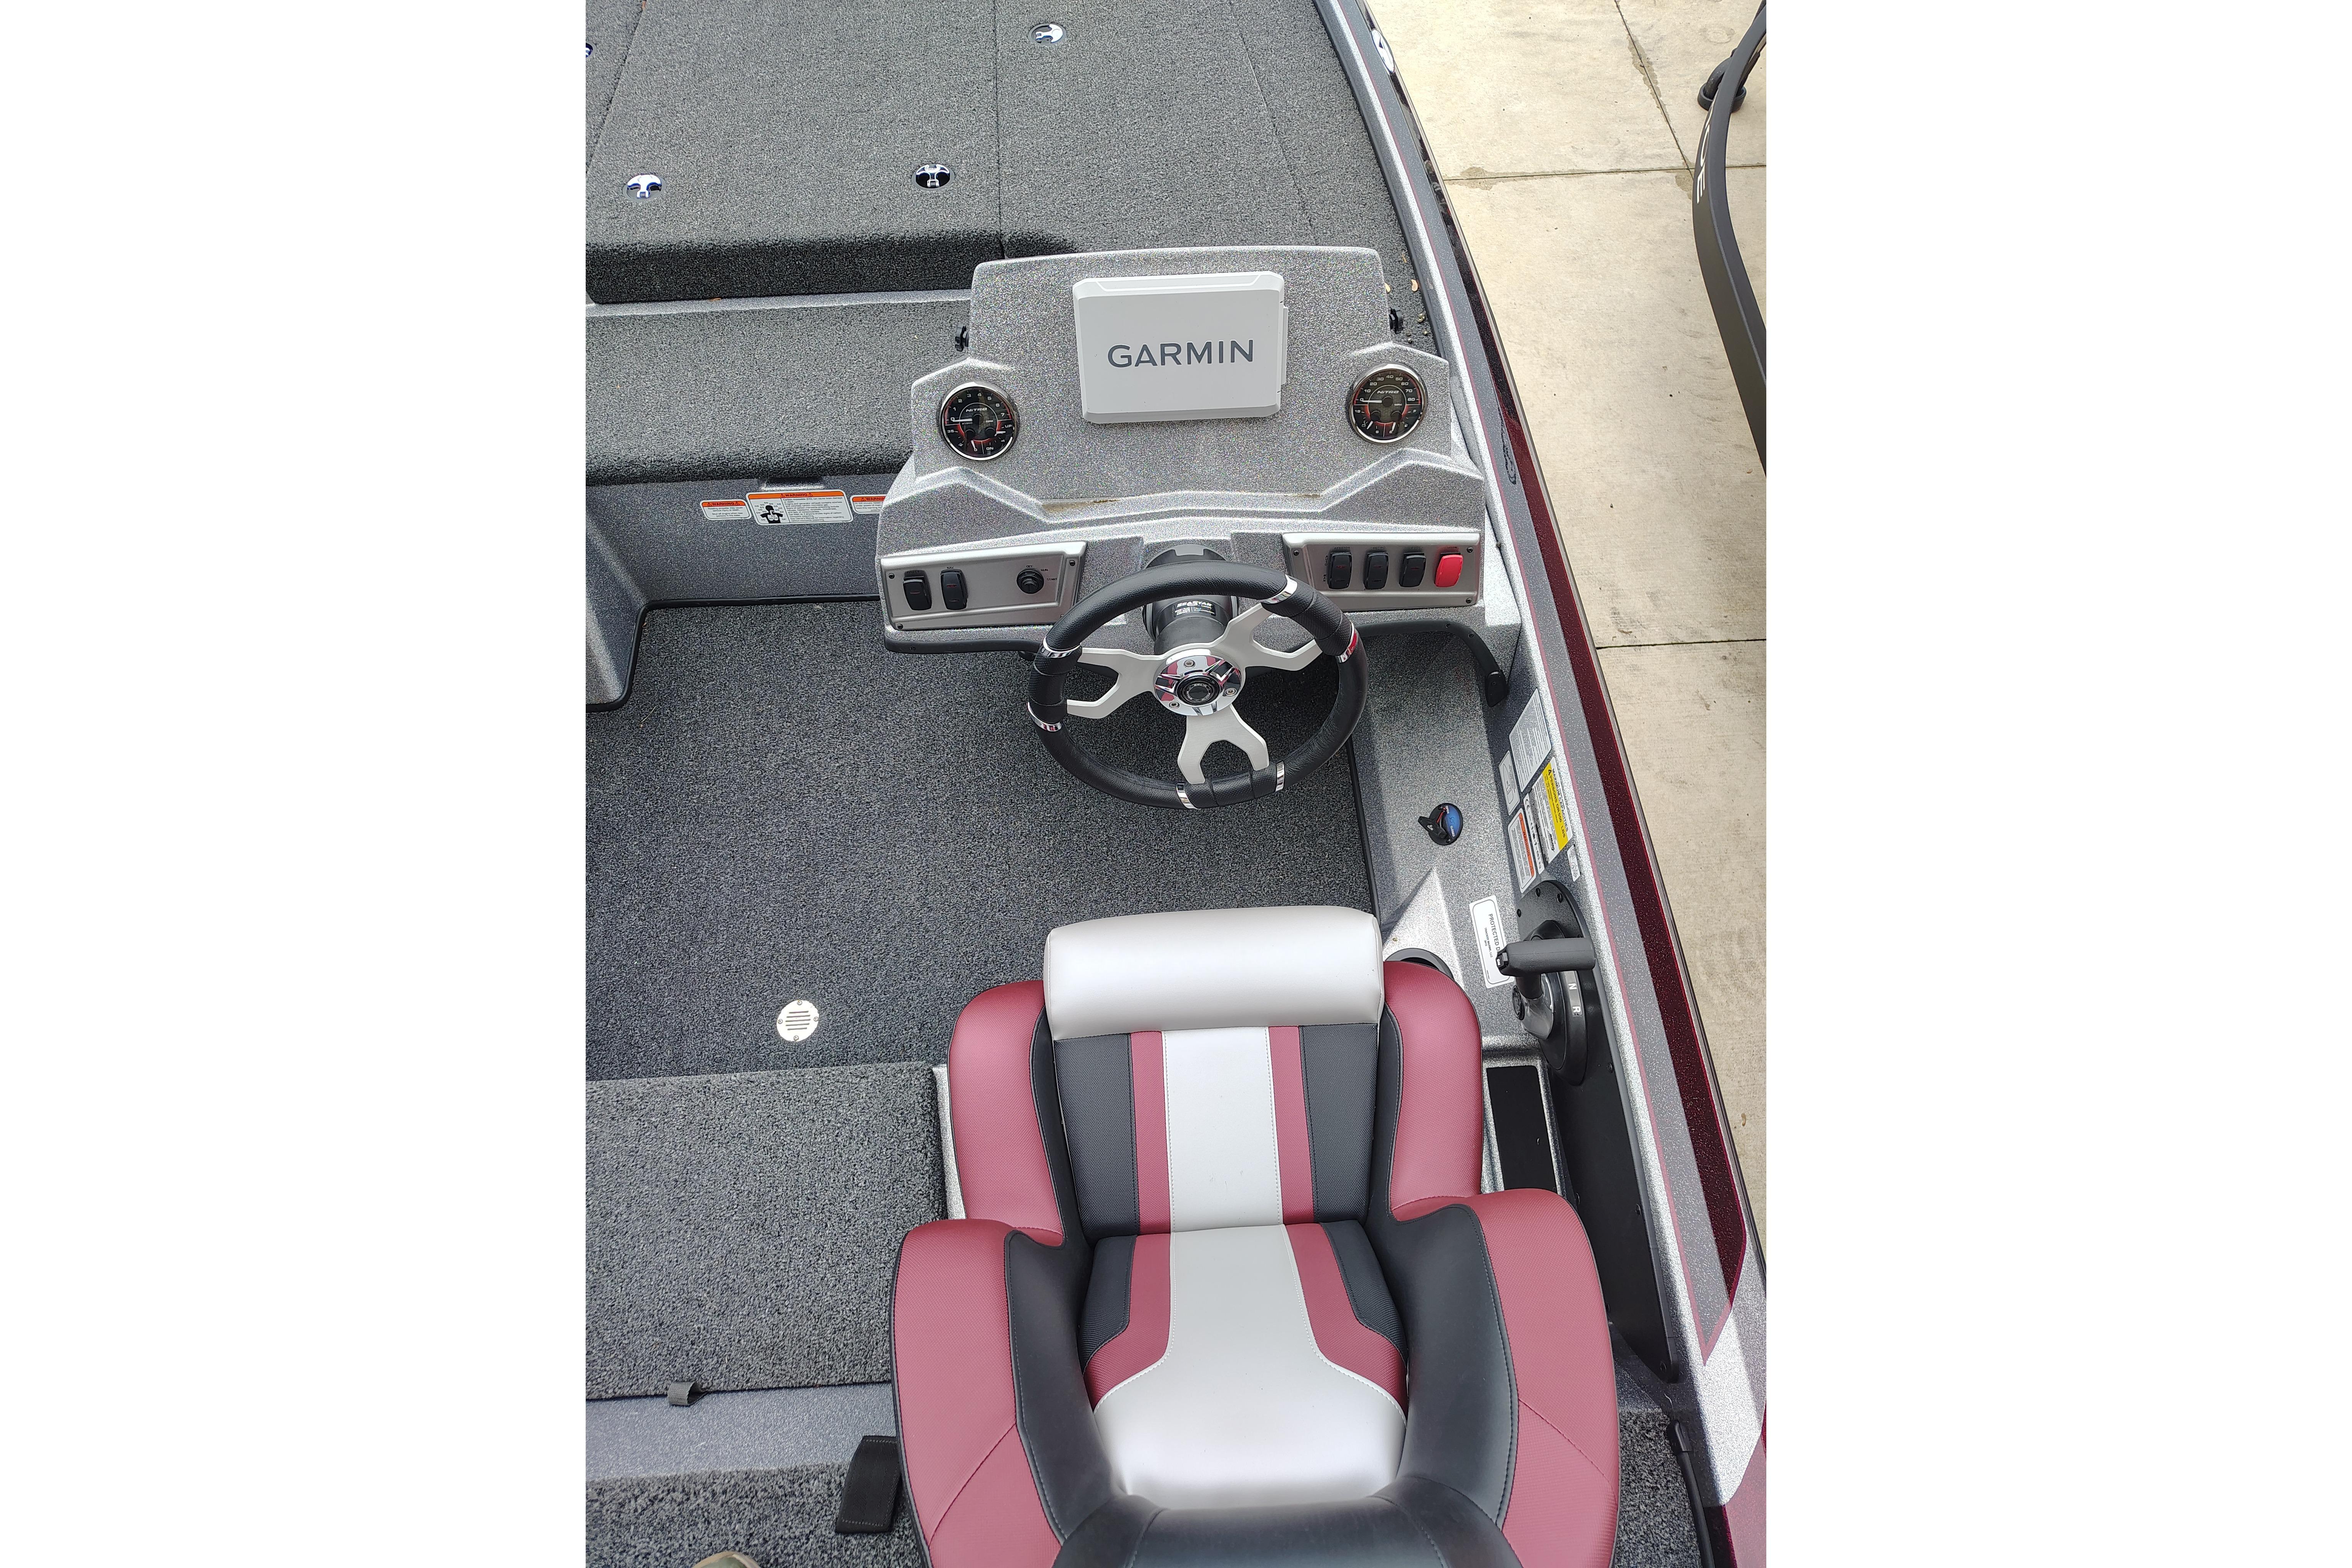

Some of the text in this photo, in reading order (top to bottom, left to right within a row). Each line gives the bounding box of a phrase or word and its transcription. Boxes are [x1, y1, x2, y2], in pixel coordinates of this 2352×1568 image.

[1108, 339, 1253, 367] GARMIN
[1549, 774, 1558, 804] PERSONS
[1555, 802, 1560, 814] OR
[1551, 767, 1569, 832] MAXIMUM CAPACITIES
[1488, 914, 1500, 946] PROTECTED
